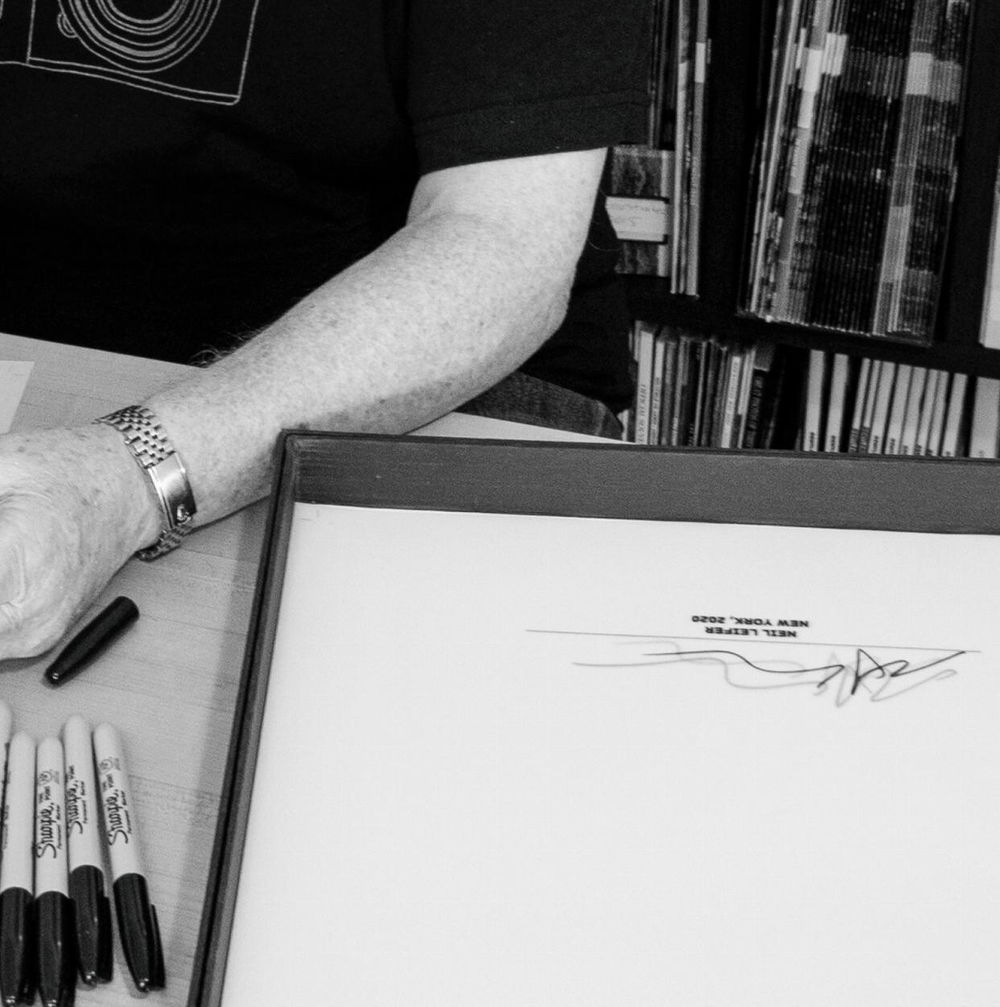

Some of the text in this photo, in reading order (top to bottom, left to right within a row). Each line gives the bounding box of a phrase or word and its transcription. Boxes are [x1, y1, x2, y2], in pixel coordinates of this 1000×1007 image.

[691, 615, 809, 628] NEW YORK, 2020
[704, 626, 797, 638] NEIL LEIFER
[36, 801, 57, 859] Sharpie
[105, 788, 129, 846] Sharpie
